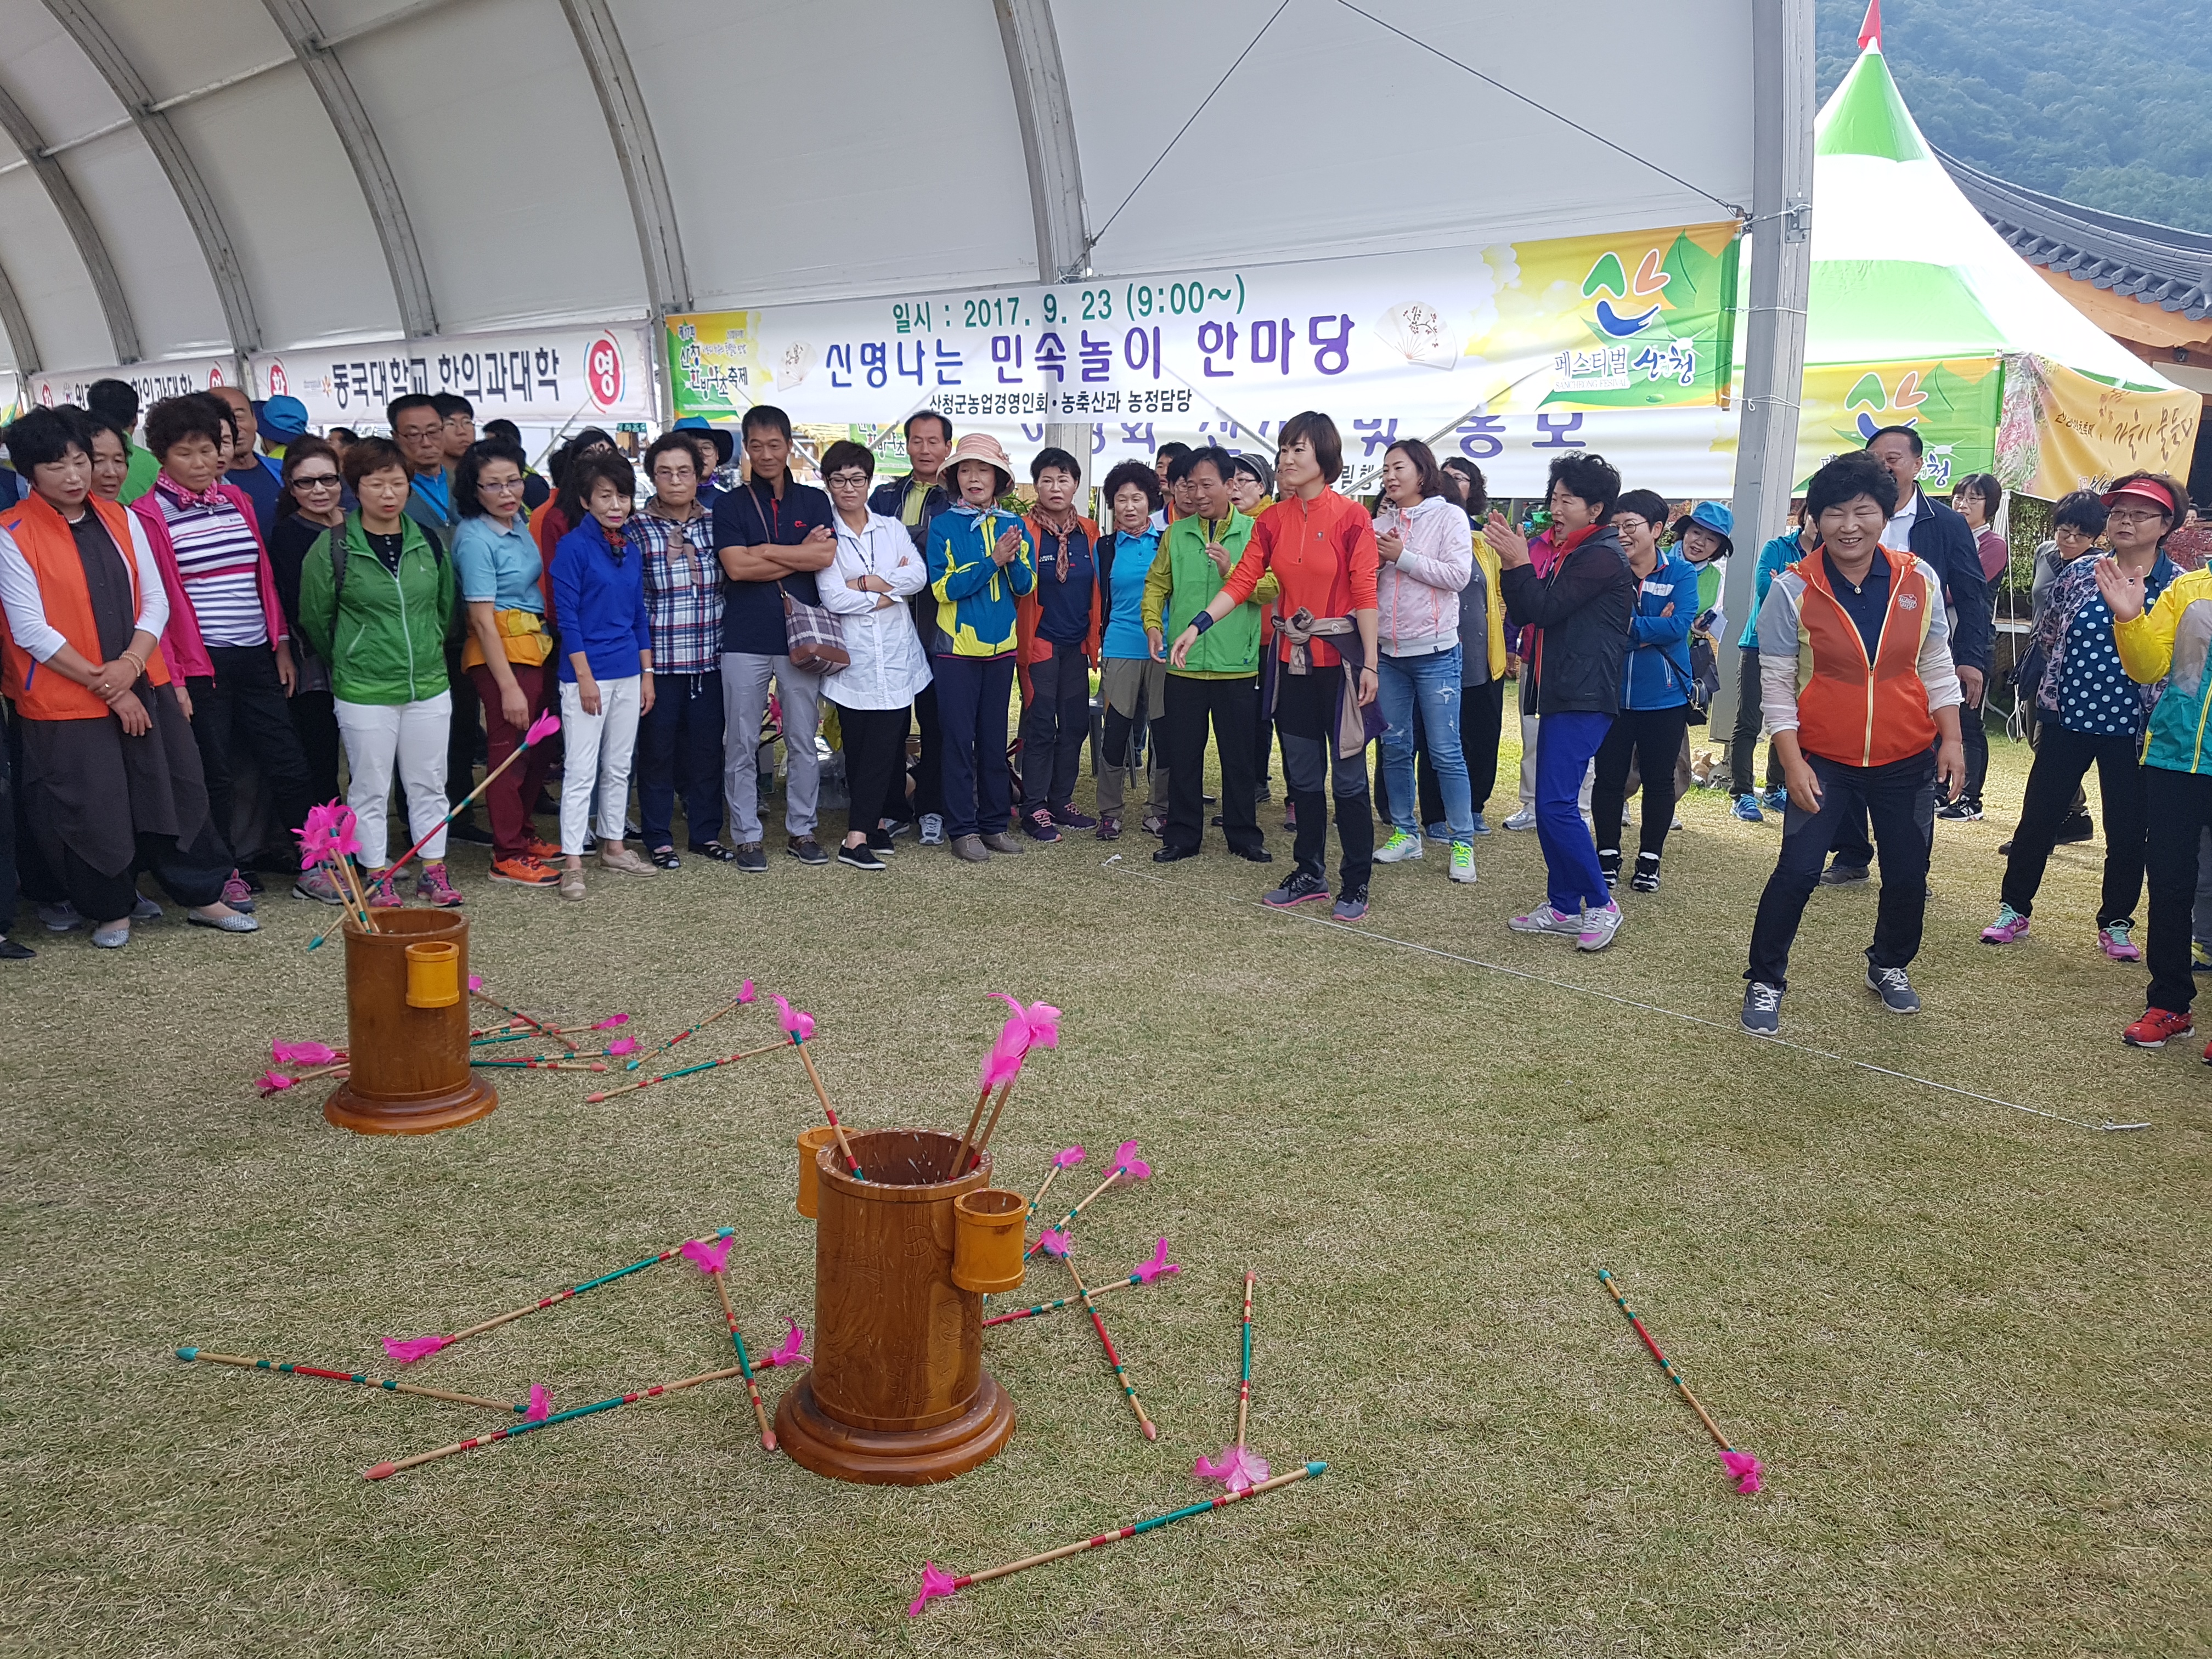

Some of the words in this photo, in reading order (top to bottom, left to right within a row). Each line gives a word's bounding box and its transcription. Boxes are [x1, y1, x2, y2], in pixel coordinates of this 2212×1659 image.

[893, 301, 932, 334] 일시
[964, 297, 1030, 328] 2017.
[1043, 293, 1067, 324] 9.
[1081, 289, 1112, 320] 23
[1126, 273, 1245, 321] (9:00~)
[594, 349, 614, 398] 영
[826, 338, 963, 388] 신명나는
[991, 325, 1160, 383] 민속놀이
[1197, 313, 1355, 377] 한마당
[1554, 347, 1626, 377] 페스티벌
[1633, 345, 1693, 383] 산청
[332, 357, 428, 410] 동국대학교
[438, 347, 560, 403] 한의과대학
[1128, 388, 1192, 413] 농정담당
[1555, 380, 1598, 389] SANCHEONG
